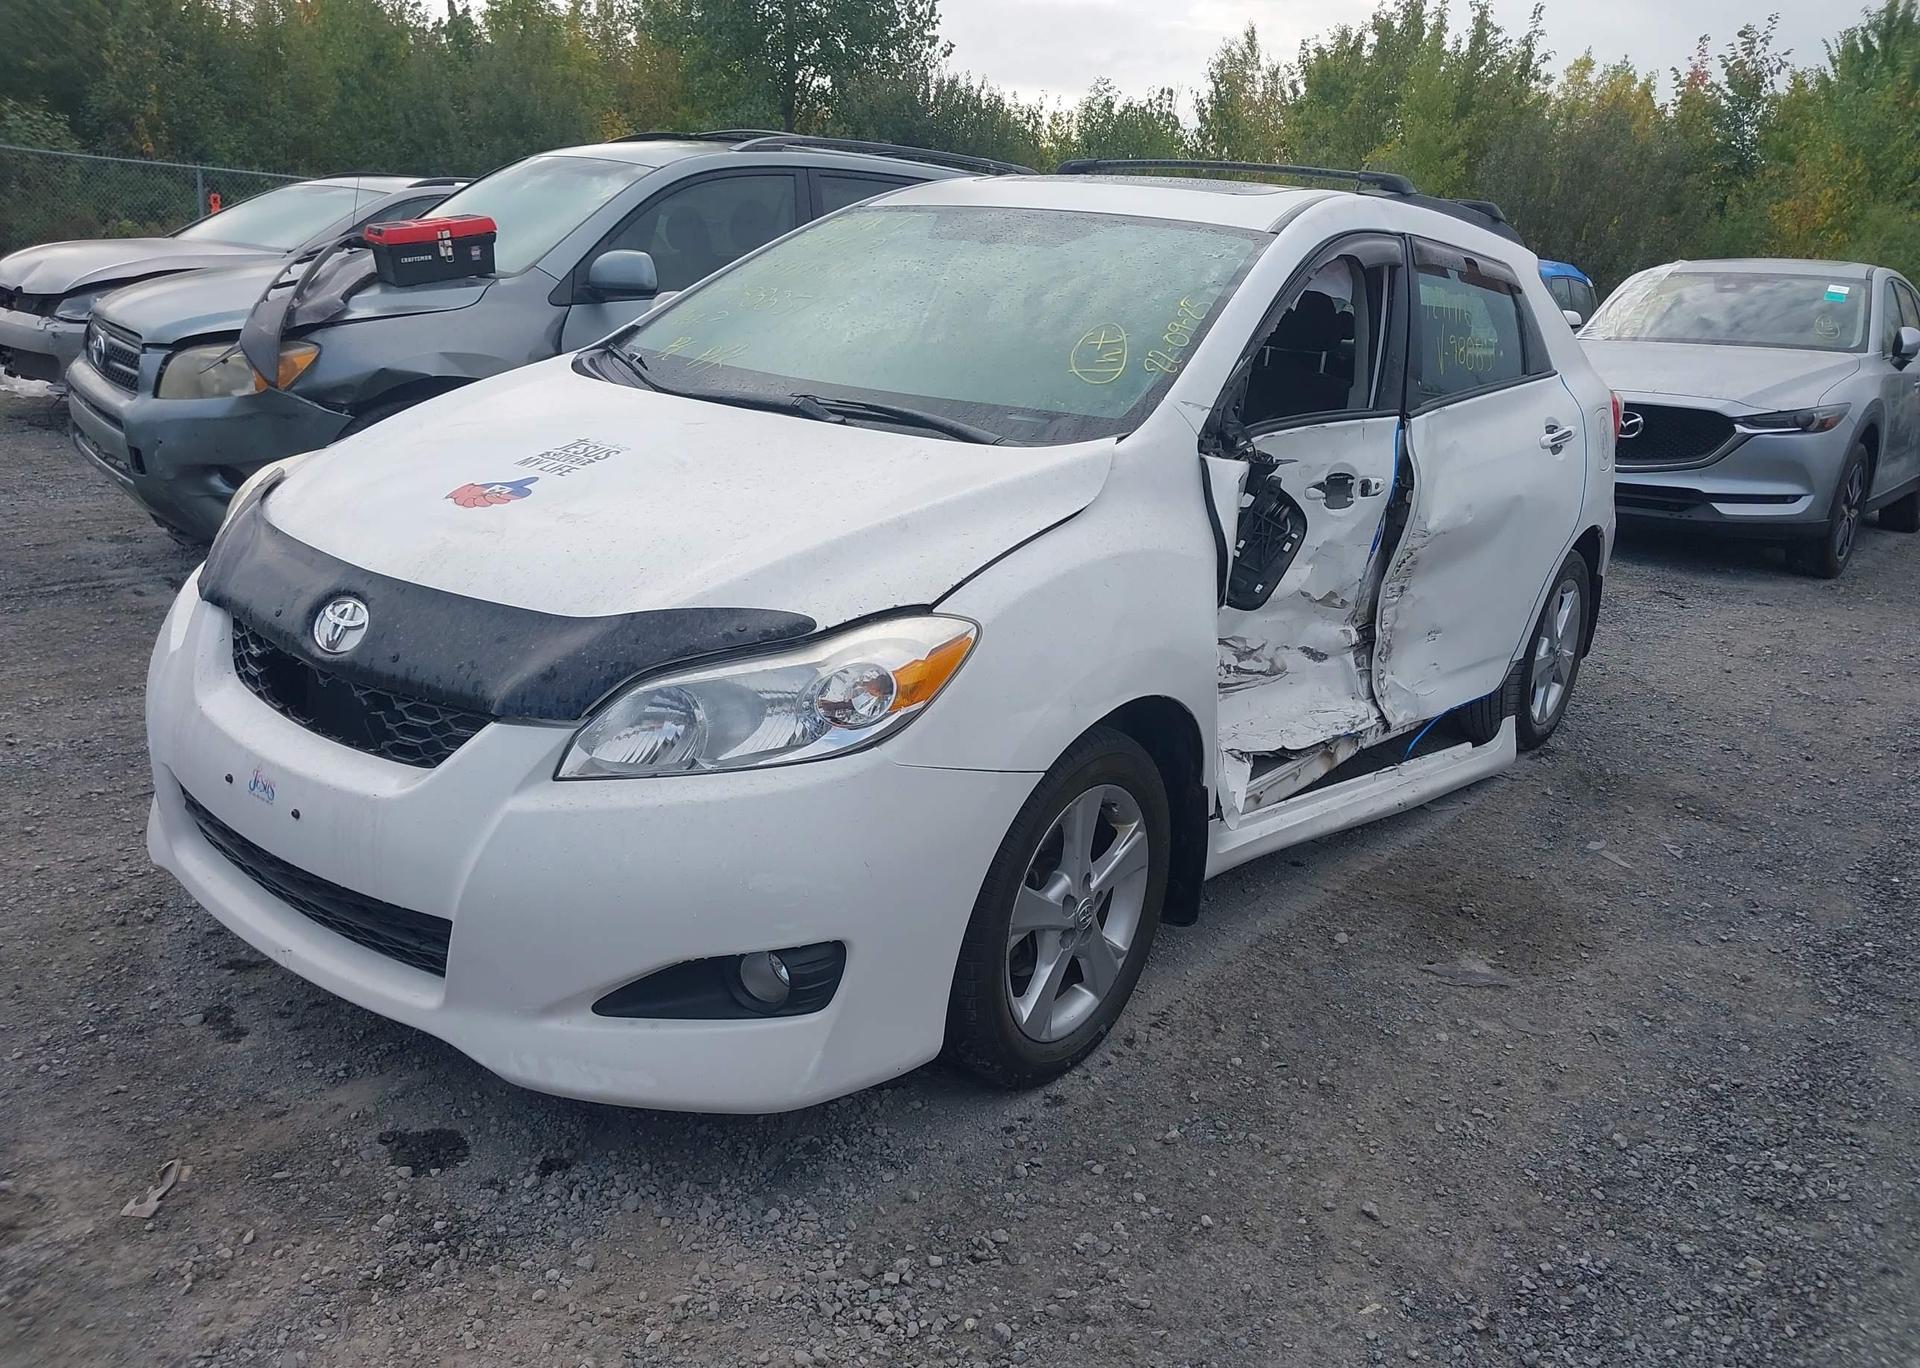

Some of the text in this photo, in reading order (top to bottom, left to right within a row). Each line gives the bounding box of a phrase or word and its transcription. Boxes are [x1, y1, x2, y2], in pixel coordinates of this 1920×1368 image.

[401, 254, 433, 264] CRAFTSMAN
[554, 437, 622, 461] JESUS
[513, 456, 580, 477] MY LIFE
